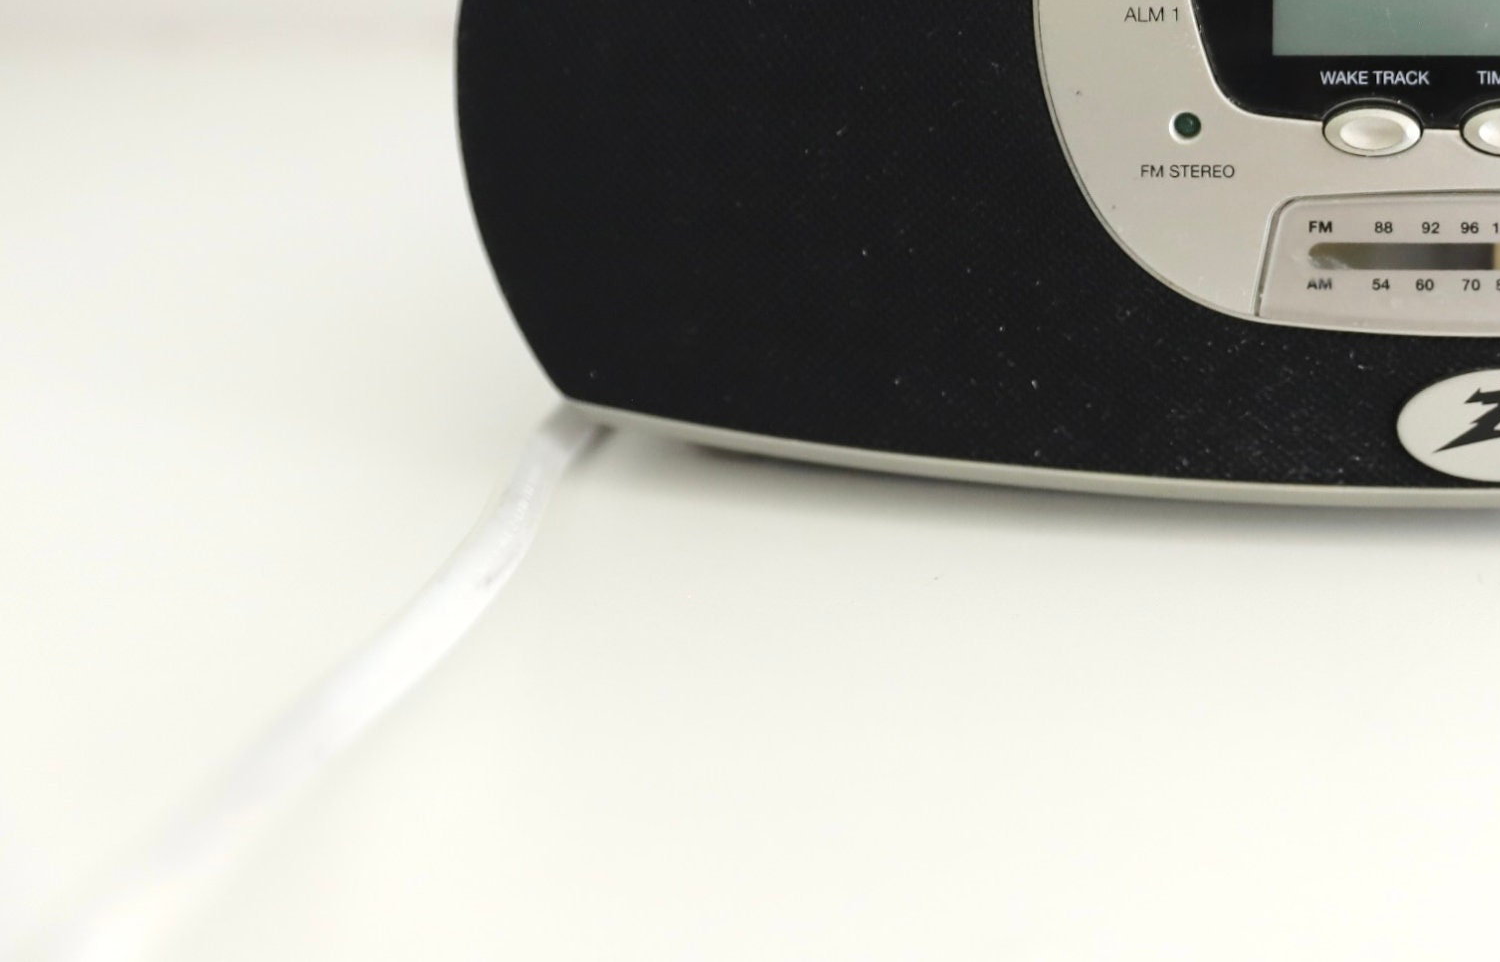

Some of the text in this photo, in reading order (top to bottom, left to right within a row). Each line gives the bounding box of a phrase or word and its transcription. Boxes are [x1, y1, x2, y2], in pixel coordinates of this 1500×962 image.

[1124, 6, 1179, 23] ALM 1
[1321, 70, 1430, 85] WAKE TRACK
[1140, 164, 1236, 179] FM STEREO
[1308, 220, 1333, 233] FM
[1374, 221, 1393, 234] 88
[1421, 221, 1440, 235] 92
[1460, 221, 1480, 235] 96
[1306, 278, 1333, 290] AM
[1372, 278, 1391, 291] 54
[1416, 279, 1434, 291] 60
[1462, 278, 1481, 292] 70
